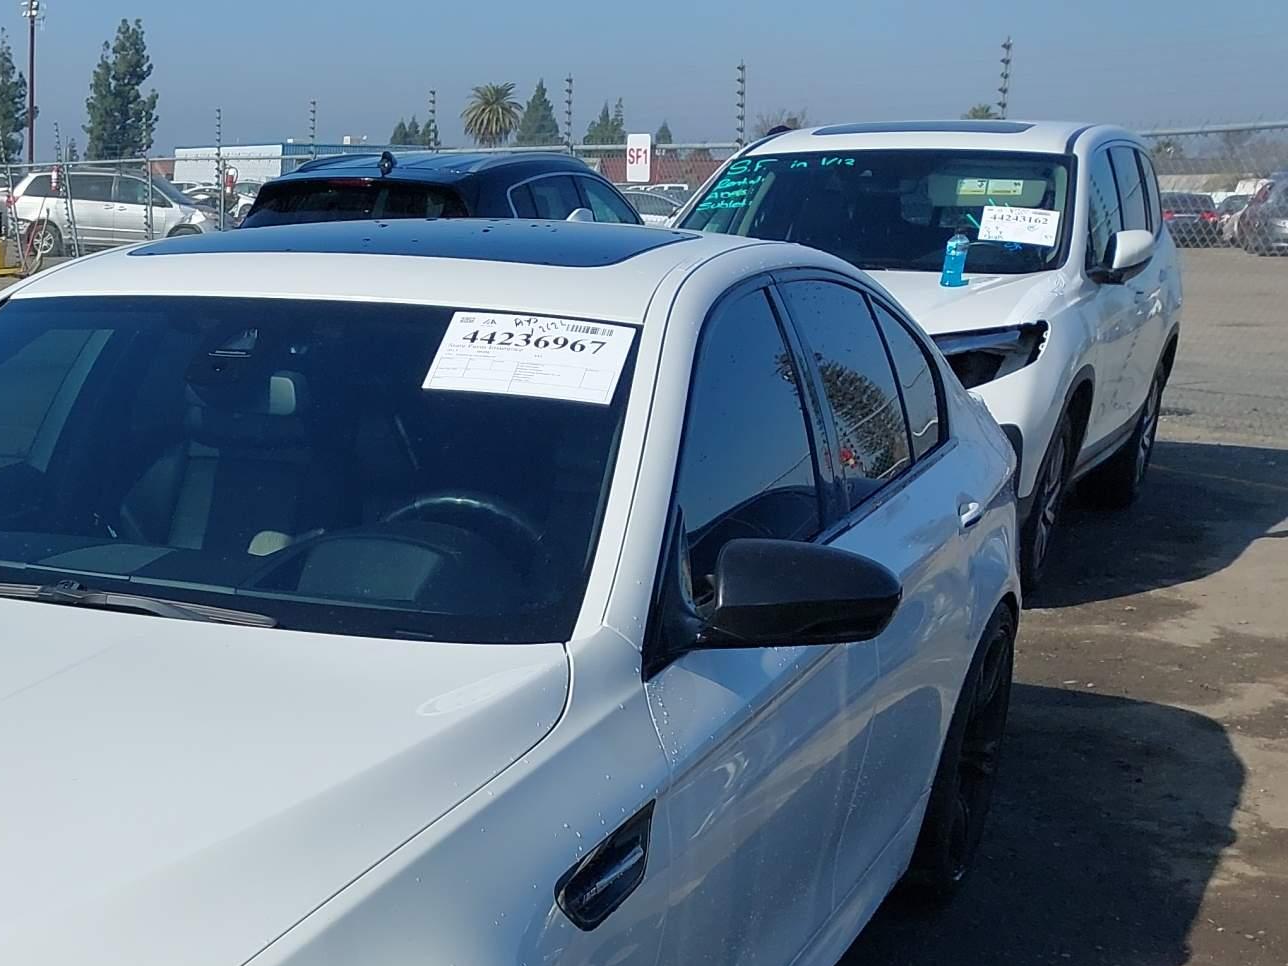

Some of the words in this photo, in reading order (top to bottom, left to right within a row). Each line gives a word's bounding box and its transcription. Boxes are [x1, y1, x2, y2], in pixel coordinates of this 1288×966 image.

[628, 147, 648, 165] SF1
[790, 160, 808, 169] in
[990, 213, 1049, 225] 44243162
[462, 330, 607, 355] 44236967
